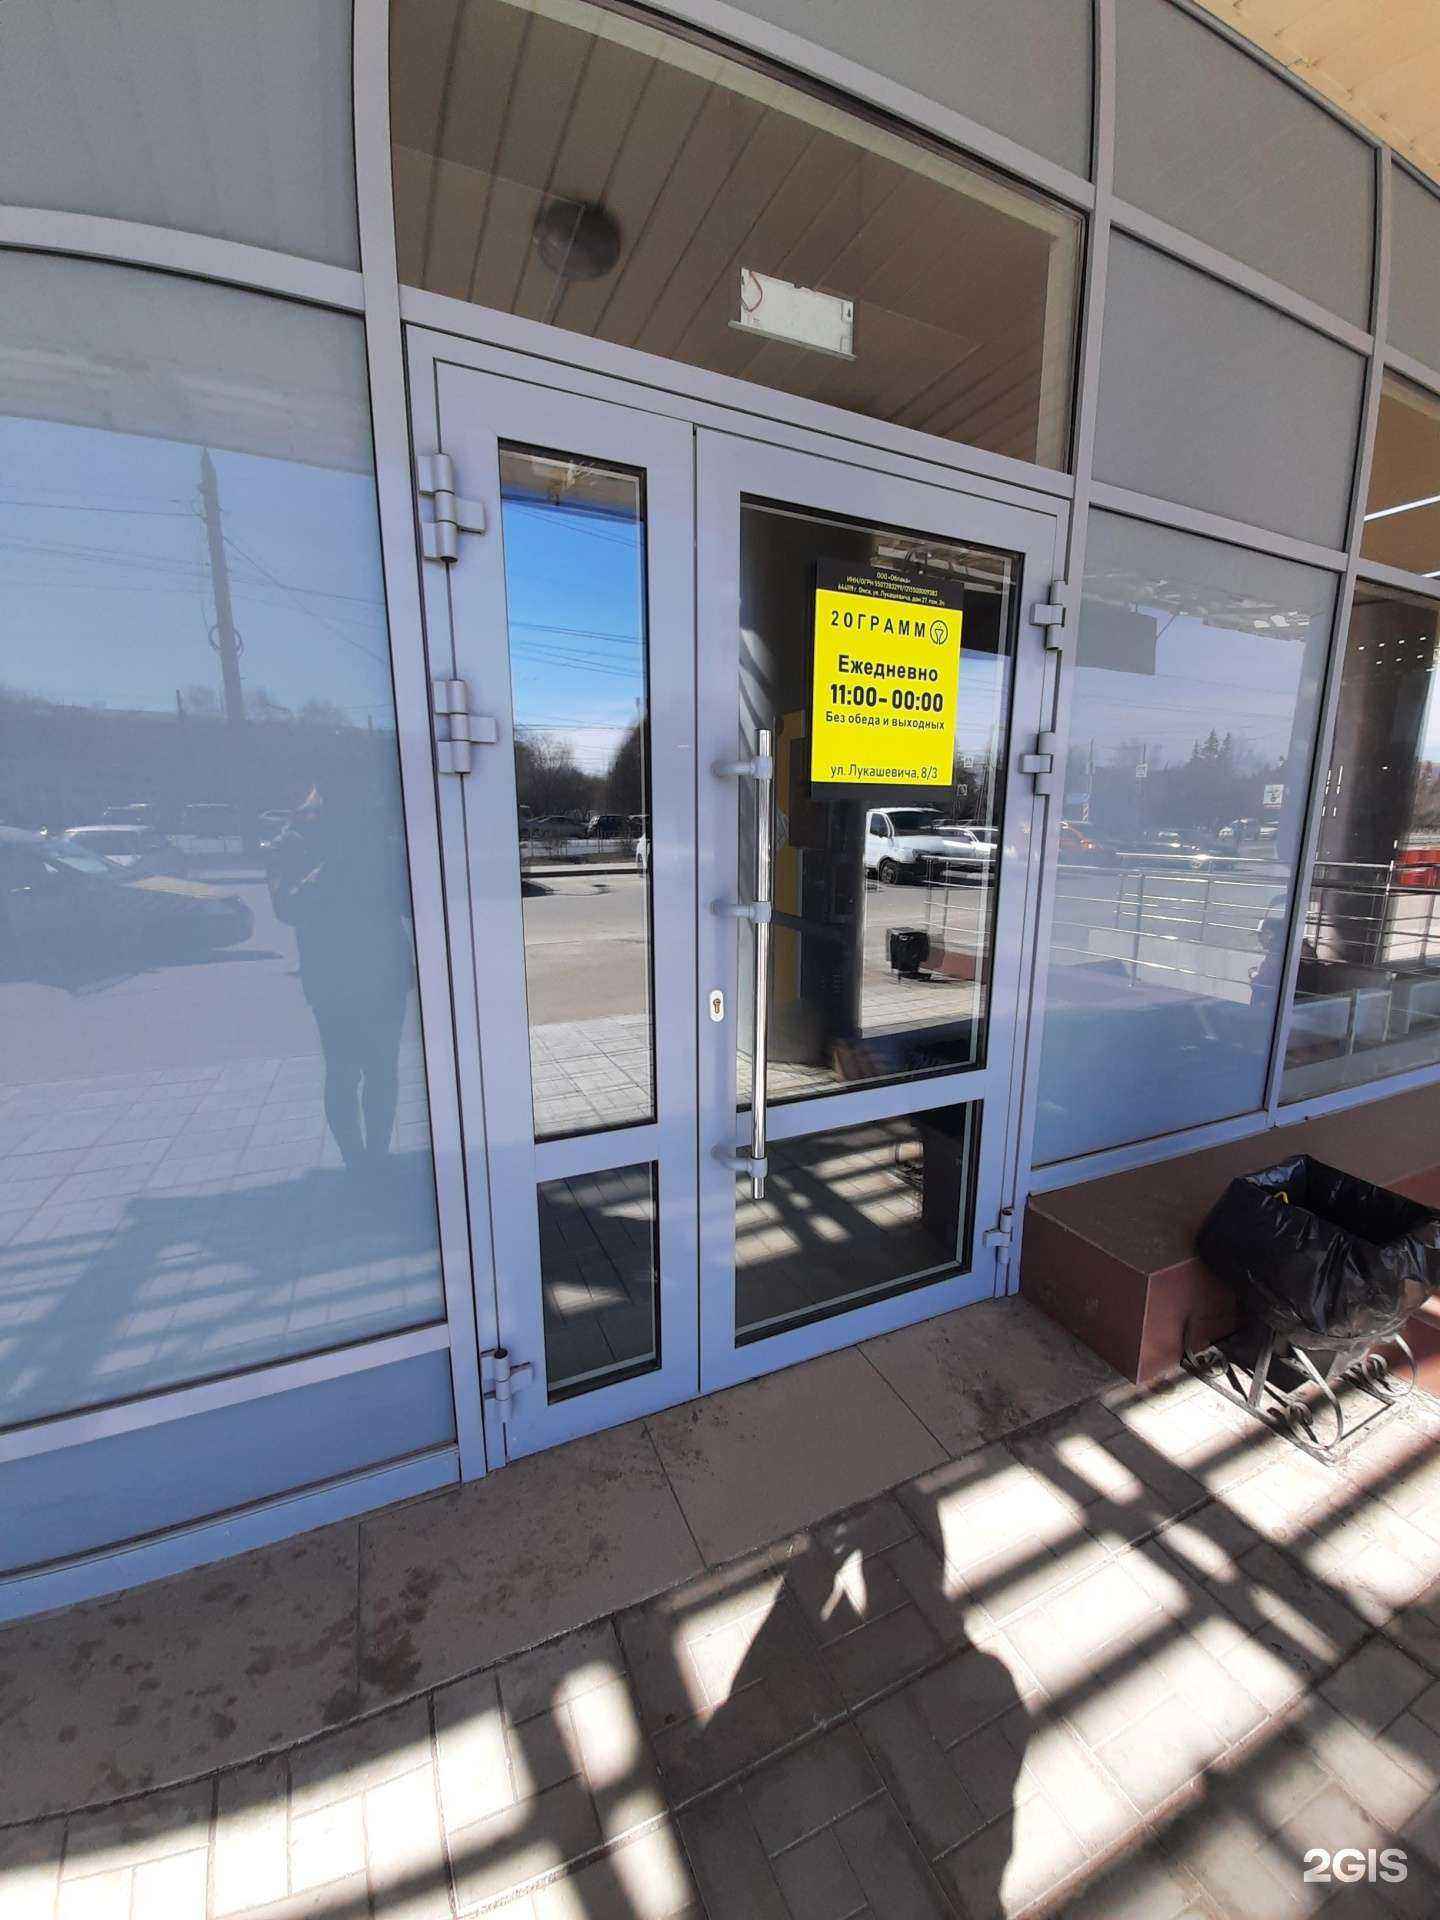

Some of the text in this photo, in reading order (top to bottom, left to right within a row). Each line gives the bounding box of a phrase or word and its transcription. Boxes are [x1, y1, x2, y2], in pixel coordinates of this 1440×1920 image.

[838, 654, 938, 682] Ежедневно
[826, 711, 945, 730] Без обеда и выходных
[830, 765, 846, 778] ул.
